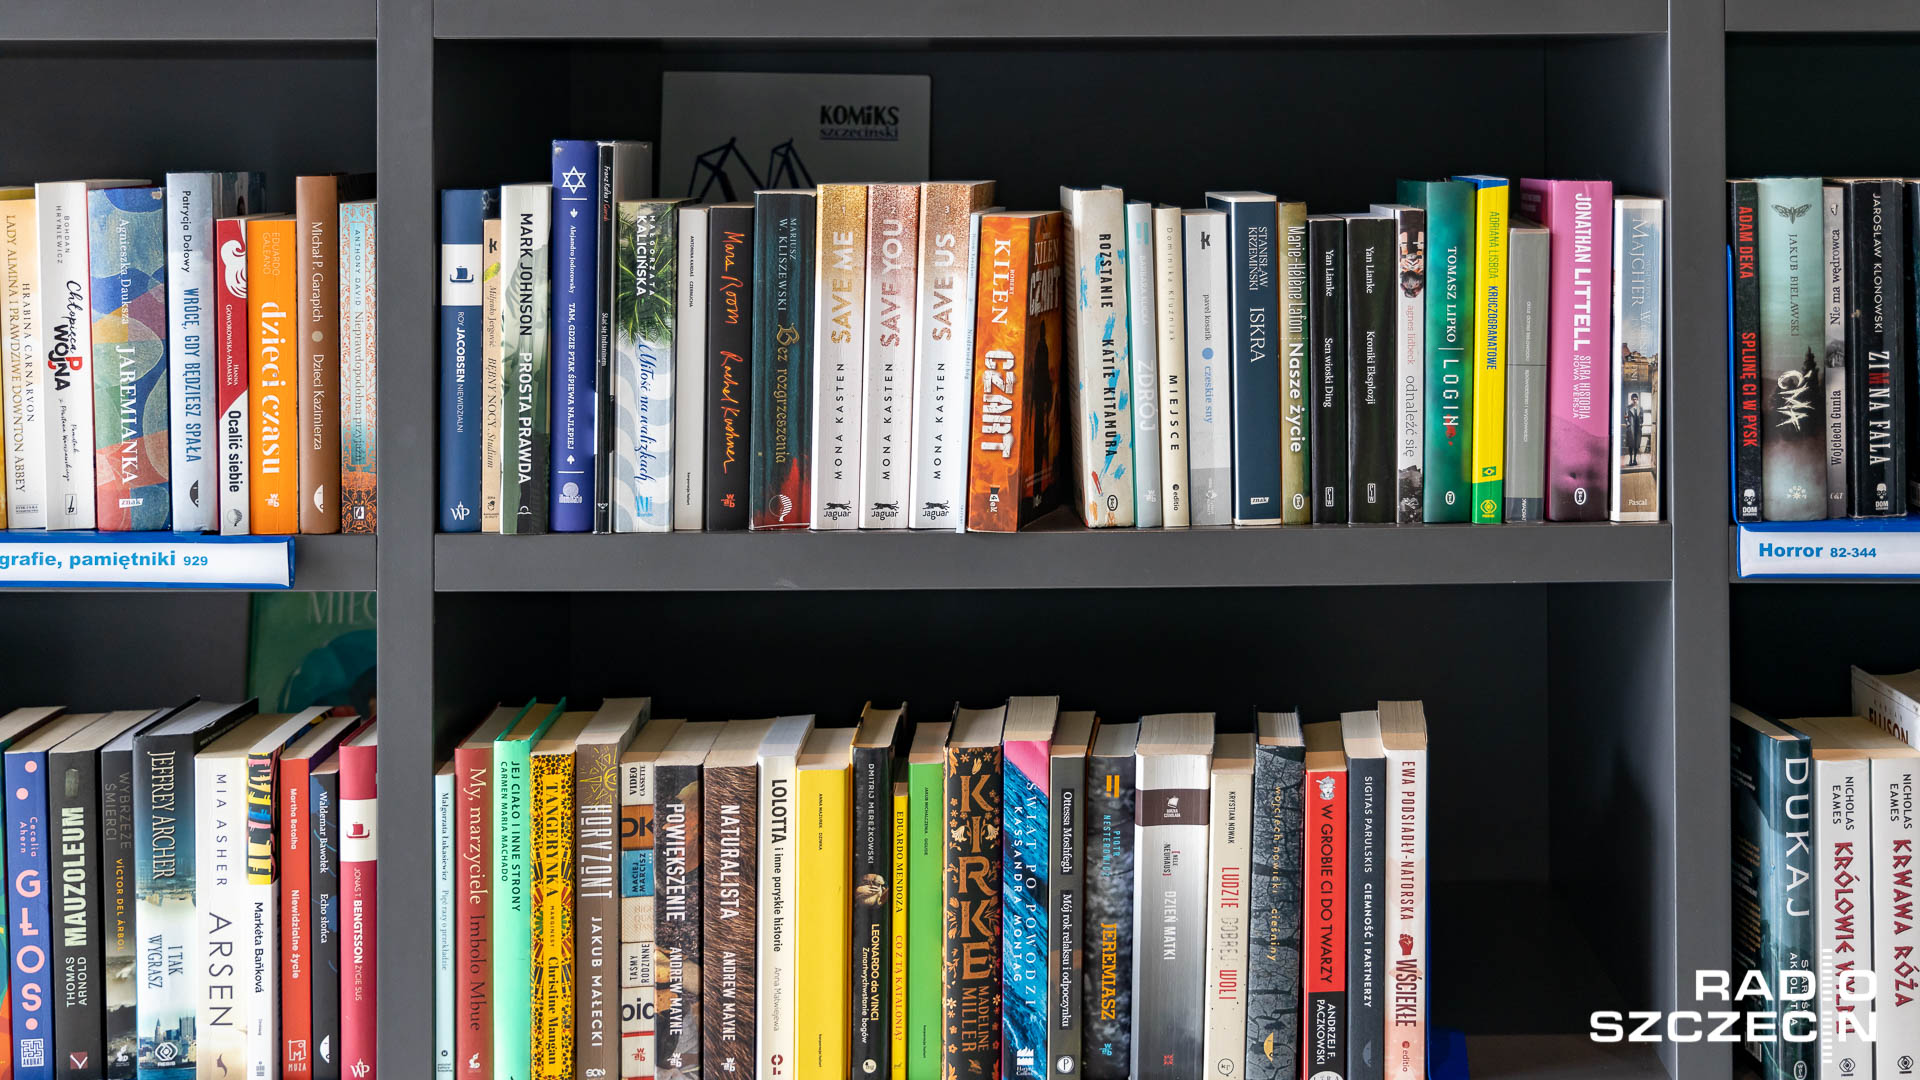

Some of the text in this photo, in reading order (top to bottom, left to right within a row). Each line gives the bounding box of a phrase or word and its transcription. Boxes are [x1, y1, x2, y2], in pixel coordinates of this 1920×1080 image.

[116, 219, 132, 324] Agnieszka Dauksza
[310, 222, 324, 322] Michał P. Garapich
[636, 215, 648, 296] KALICIŃSKA
[1248, 226, 1259, 290] KRZEMIŃSKI
[1258, 226, 1268, 288] STANISŁAW
[1573, 194, 1592, 352] JONATHAN LITTELL
[1738, 206, 1754, 279] ADAM DEKA
[569, 303, 578, 323] TAM,
[831, 232, 854, 344] SAVE ME
[880, 219, 903, 348] SAVE YOU
[932, 234, 956, 342] SAVE US
[991, 239, 1011, 325] KILEN
[1408, 305, 1416, 330] agnes
[1486, 211, 1500, 370] ADRIANA LISBOA KRUCZOGRANATOWE
[1788, 234, 1800, 337] JAKUB BIELAWSKI
[22, 283, 35, 422] HRABINA CARNARVON
[261, 302, 287, 386] dzieci
[456, 327, 466, 382] JACOBSEN
[518, 212, 534, 484] MARK JOHNSON PROSTA PRAWDA
[568, 352, 576, 371] PTAK
[569, 326, 577, 350] GDZIE
[1098, 234, 1118, 457] ROZSTANIE KATIE KITAMURA
[1249, 308, 1266, 362] ISKRA
[1322, 338, 1334, 408] Sen wioski Ding
[1442, 246, 1460, 426] TOMASZ LIPKO LOGIN
[116, 345, 139, 485] JAREMIANKA
[313, 354, 325, 450] Dzieci Kazimierza
[456, 384, 464, 433] NIEWIDZIALNI
[834, 363, 844, 480] MONA KASTEN
[980, 350, 1015, 458] CZART
[1168, 374, 1180, 450] MIEJSCE
[1285, 342, 1306, 453] Nasze życie
[1578, 355, 1591, 420] STARA HISTORIA
[1742, 384, 1757, 396] CI
[1742, 400, 1758, 411] W
[1868, 351, 1891, 465] ZIMNA FALA
[228, 410, 244, 493] Ocalić siebie
[261, 394, 280, 474] czasu
[568, 407, 576, 450] NAJLEPIEJ
[1742, 416, 1758, 448] PYSK
[69, 550, 176, 570] pamiętniki
[183, 556, 208, 566] 929
[1759, 542, 1877, 558] Horror 82-344
[290, 788, 298, 812] Martha
[629, 766, 638, 796] VIDEO
[1401, 761, 1416, 785] EWA
[1845, 776, 1854, 830] NICHOLAS
[1902, 774, 1912, 830] NICHOLAS
[19, 821, 28, 854] Ahern
[29, 816, 38, 858] Cecelia
[319, 792, 328, 836] Waldemar
[440, 792, 449, 834] Małgorzata
[1102, 814, 1112, 878] NESTEROWICZ
[1112, 830, 1120, 857] PIOTR
[1785, 756, 1810, 918] DUKAJ
[62, 806, 88, 948] MAUZOLEUM
[580, 804, 613, 899] HORYZONT
[720, 804, 740, 920] NATURALISTA
[895, 811, 904, 914] EDUARDO MENDOZA
[1220, 866, 1240, 908] LUDZIE
[1892, 839, 1912, 935] KRWAWA
[254, 902, 264, 946] Markéta
[320, 894, 330, 944] Echo słońca
[463, 768, 488, 1030] My, marzyciele Imbolo Mbue
[1012, 806, 1023, 982] KASSANDRA MONTAG
[1320, 804, 1334, 984] W GROBIE CI DO TWARZY
[66, 956, 76, 1008] THOMAS
[78, 956, 88, 1006] ARNOLD
[208, 912, 234, 1026] ARSEN
[591, 916, 604, 1048] JAKUB MAŁECKI
[669, 947, 683, 1036] ANDREW MAYNE
[722, 951, 736, 1041] ANDREW MAYNE
[870, 924, 880, 1021] LEONARDO da VINCI
[1100, 922, 1117, 1020] JEREMIASZ
[1218, 969, 1238, 1000] WOLI
[962, 988, 978, 1052] MILLER
[978, 986, 990, 1052] MADELINE
[1316, 999, 1326, 1065] PACZKOWSKI
